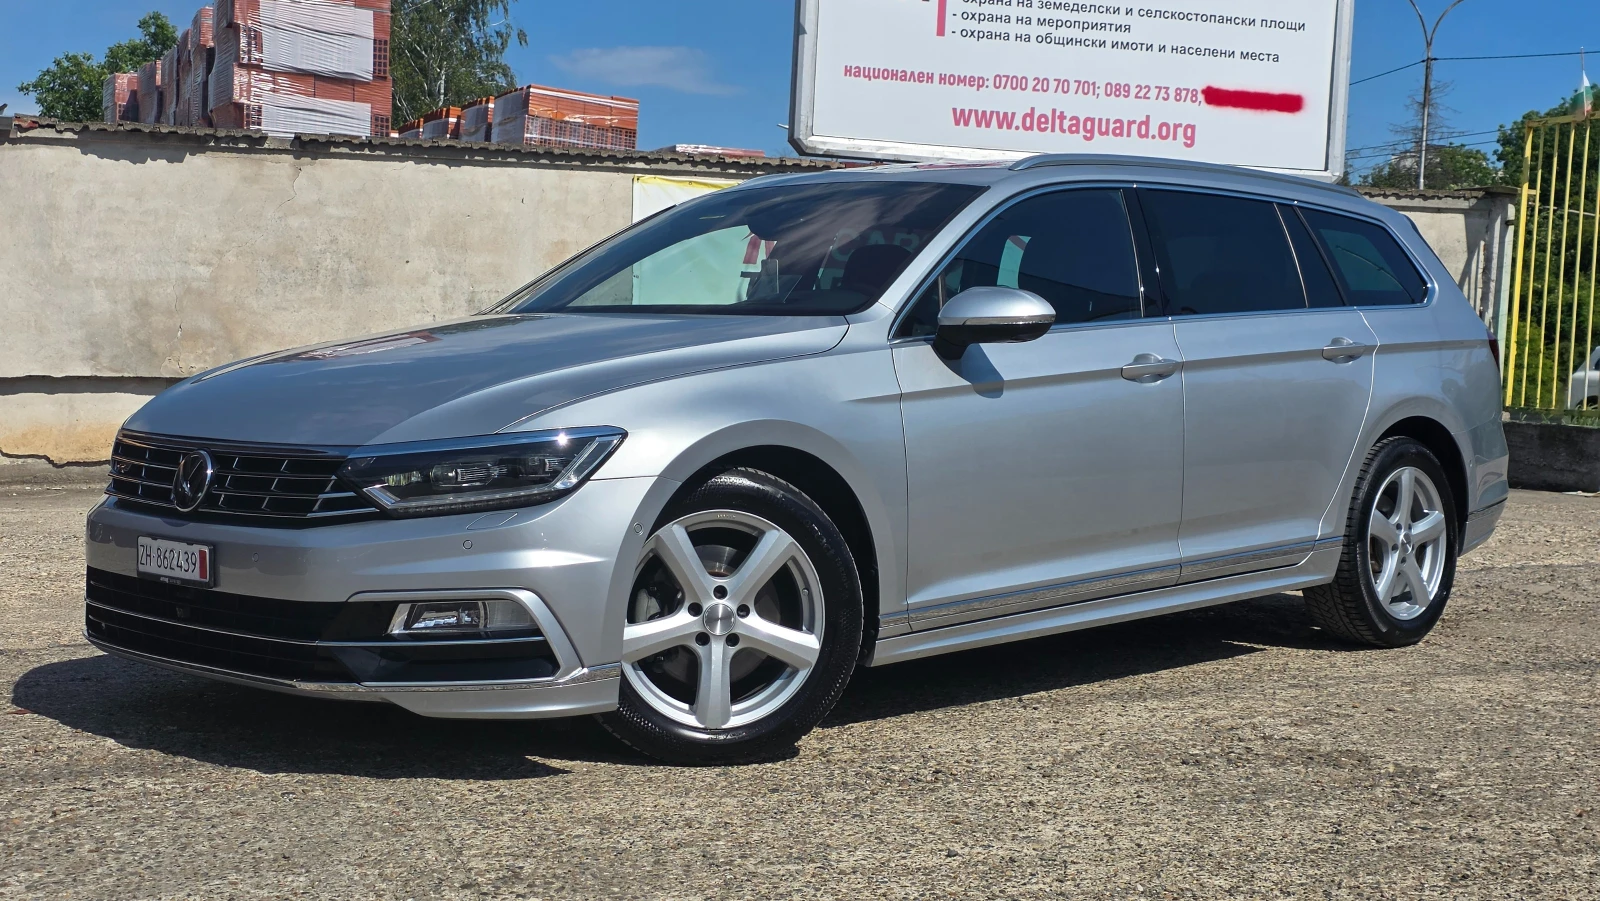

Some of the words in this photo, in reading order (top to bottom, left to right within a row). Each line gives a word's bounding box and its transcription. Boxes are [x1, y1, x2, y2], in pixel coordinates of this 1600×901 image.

[961, 11, 1011, 24] охрана
[1015, 15, 1032, 26] на
[1036, 17, 1131, 33] мероприятия
[1016, 0, 1033, 9] на
[1037, 0, 1121, 16] земеделски
[1125, 6, 1133, 17] и
[1137, 8, 1256, 27] селскостопански
[1260, 17, 1306, 33] площи
[960, 28, 1010, 41] охрана
[1014, 32, 1031, 43] на
[1035, 33, 1107, 48] общински
[1111, 40, 1154, 52] имоти
[1158, 44, 1167, 54] и
[1170, 44, 1235, 59] населени
[1239, 50, 1280, 63] места
[843, 65, 934, 84] национален
[938, 72, 990, 91] номер:
[993, 74, 1029, 92] 0700
[1031, 77, 1050, 93] 20
[1053, 78, 1070, 94] 70
[1073, 79, 1101, 99] 701;
[1104, 82, 1131, 98] 089
[1134, 84, 1151, 100] 22
[1154, 85, 1170, 102] 73
[951, 107, 1197, 148] www.deltaguard.org
